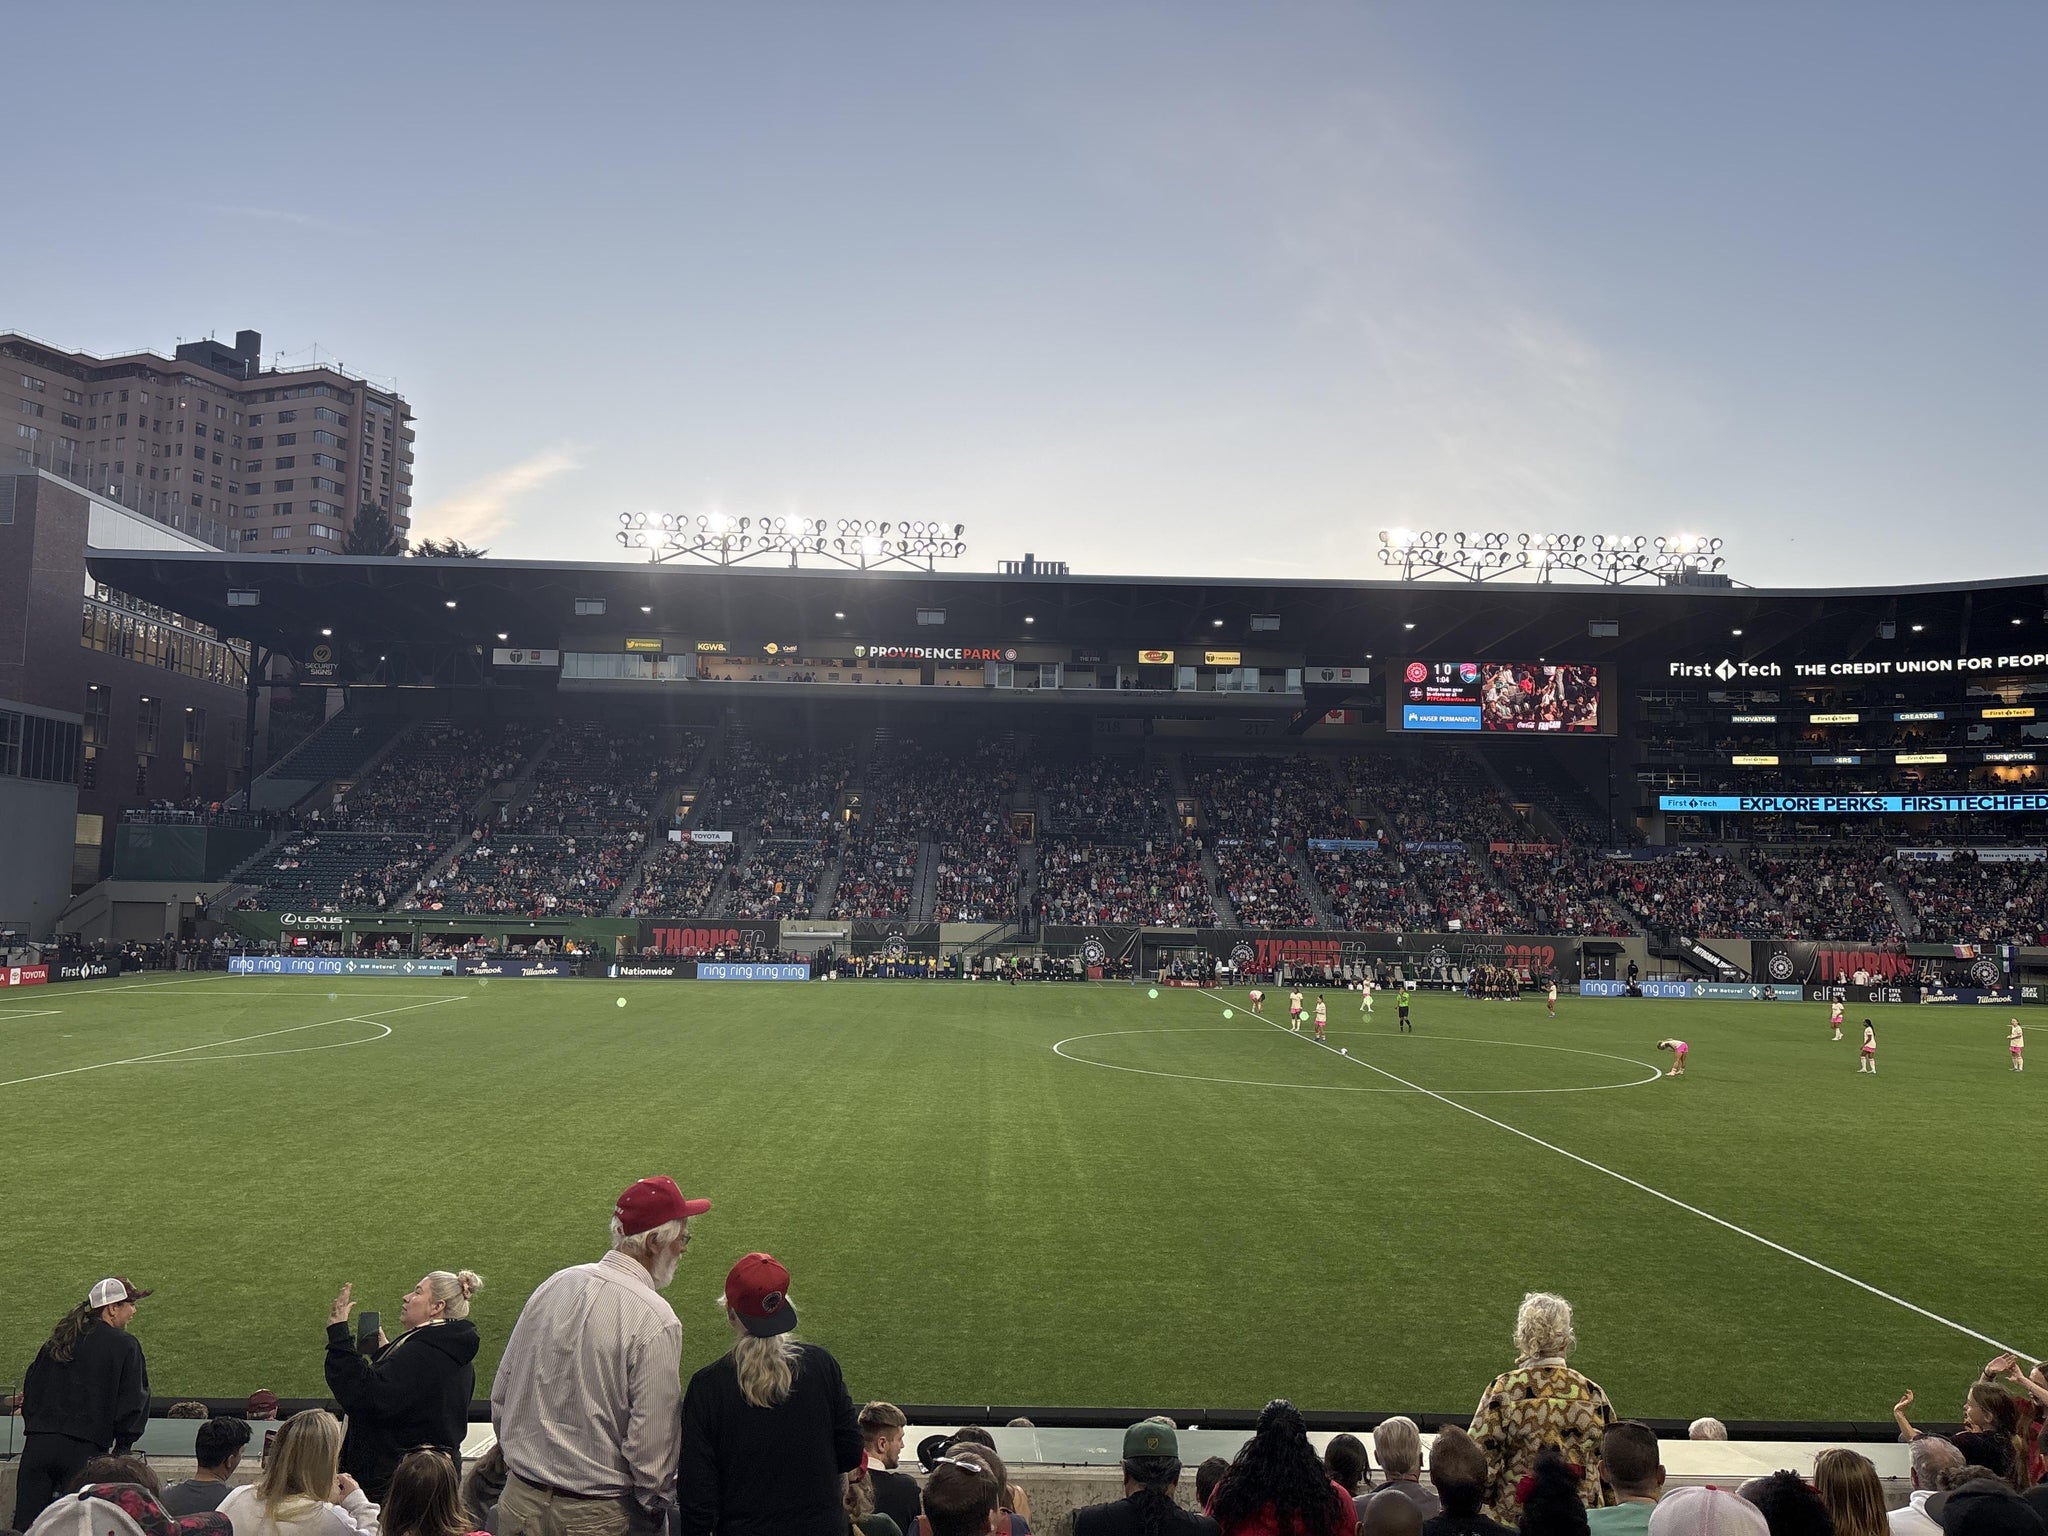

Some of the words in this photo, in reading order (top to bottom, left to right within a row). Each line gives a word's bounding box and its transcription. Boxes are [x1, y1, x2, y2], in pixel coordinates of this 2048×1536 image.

[870, 647, 962, 659] PROVIDENCE
[963, 649, 1001, 660] PARK
[304, 662, 339, 670] SECURITY
[310, 668, 333, 676] SIGNS
[1434, 664, 1440, 675] 1
[1444, 664, 1451, 675] 0
[1670, 662, 1712, 677] First
[1738, 662, 1781, 677] Tech
[1794, 664, 1826, 675] THE
[1830, 662, 1891, 675] CREDIT
[1896, 659, 1952, 673] UNION
[1957, 657, 1992, 670] FOR
[1985, 753, 2033, 761] DISRUPTORS
[1668, 799, 1687, 807] First
[1739, 798, 1820, 811] EXPLORE
[1824, 798, 1888, 811] PERKS:
[1901, 796, 2048, 811] FIRSTTECHFED
[652, 928, 740, 957] THORNS
[1255, 939, 1341, 969] THORNS
[1504, 945, 1555, 970] 2012
[61, 965, 80, 978] First
[90, 964, 107, 975] Tech
[231, 959, 254, 972] ring
[258, 959, 281, 973] ring
[291, 959, 315, 973] ring
[318, 960, 342, 974] ring
[521, 966, 559, 976] Tillamook
[620, 966, 673, 976] Nationwide
[703, 964, 725, 979] ring
[730, 964, 752, 979] ring
[756, 964, 778, 979] ring
[782, 965, 805, 979] ring
[1818, 950, 1912, 981] THORNS
[22, 970, 45, 980] TOYOTA
[1585, 982, 1608, 995] ring
[1611, 982, 1627, 993] rin
[1663, 983, 1686, 997] ring
[1813, 986, 1832, 1001] elf
[1869, 987, 1888, 1002] elf
[1927, 993, 1958, 1003] illamook
[1976, 994, 2013, 1004] Tillamook
